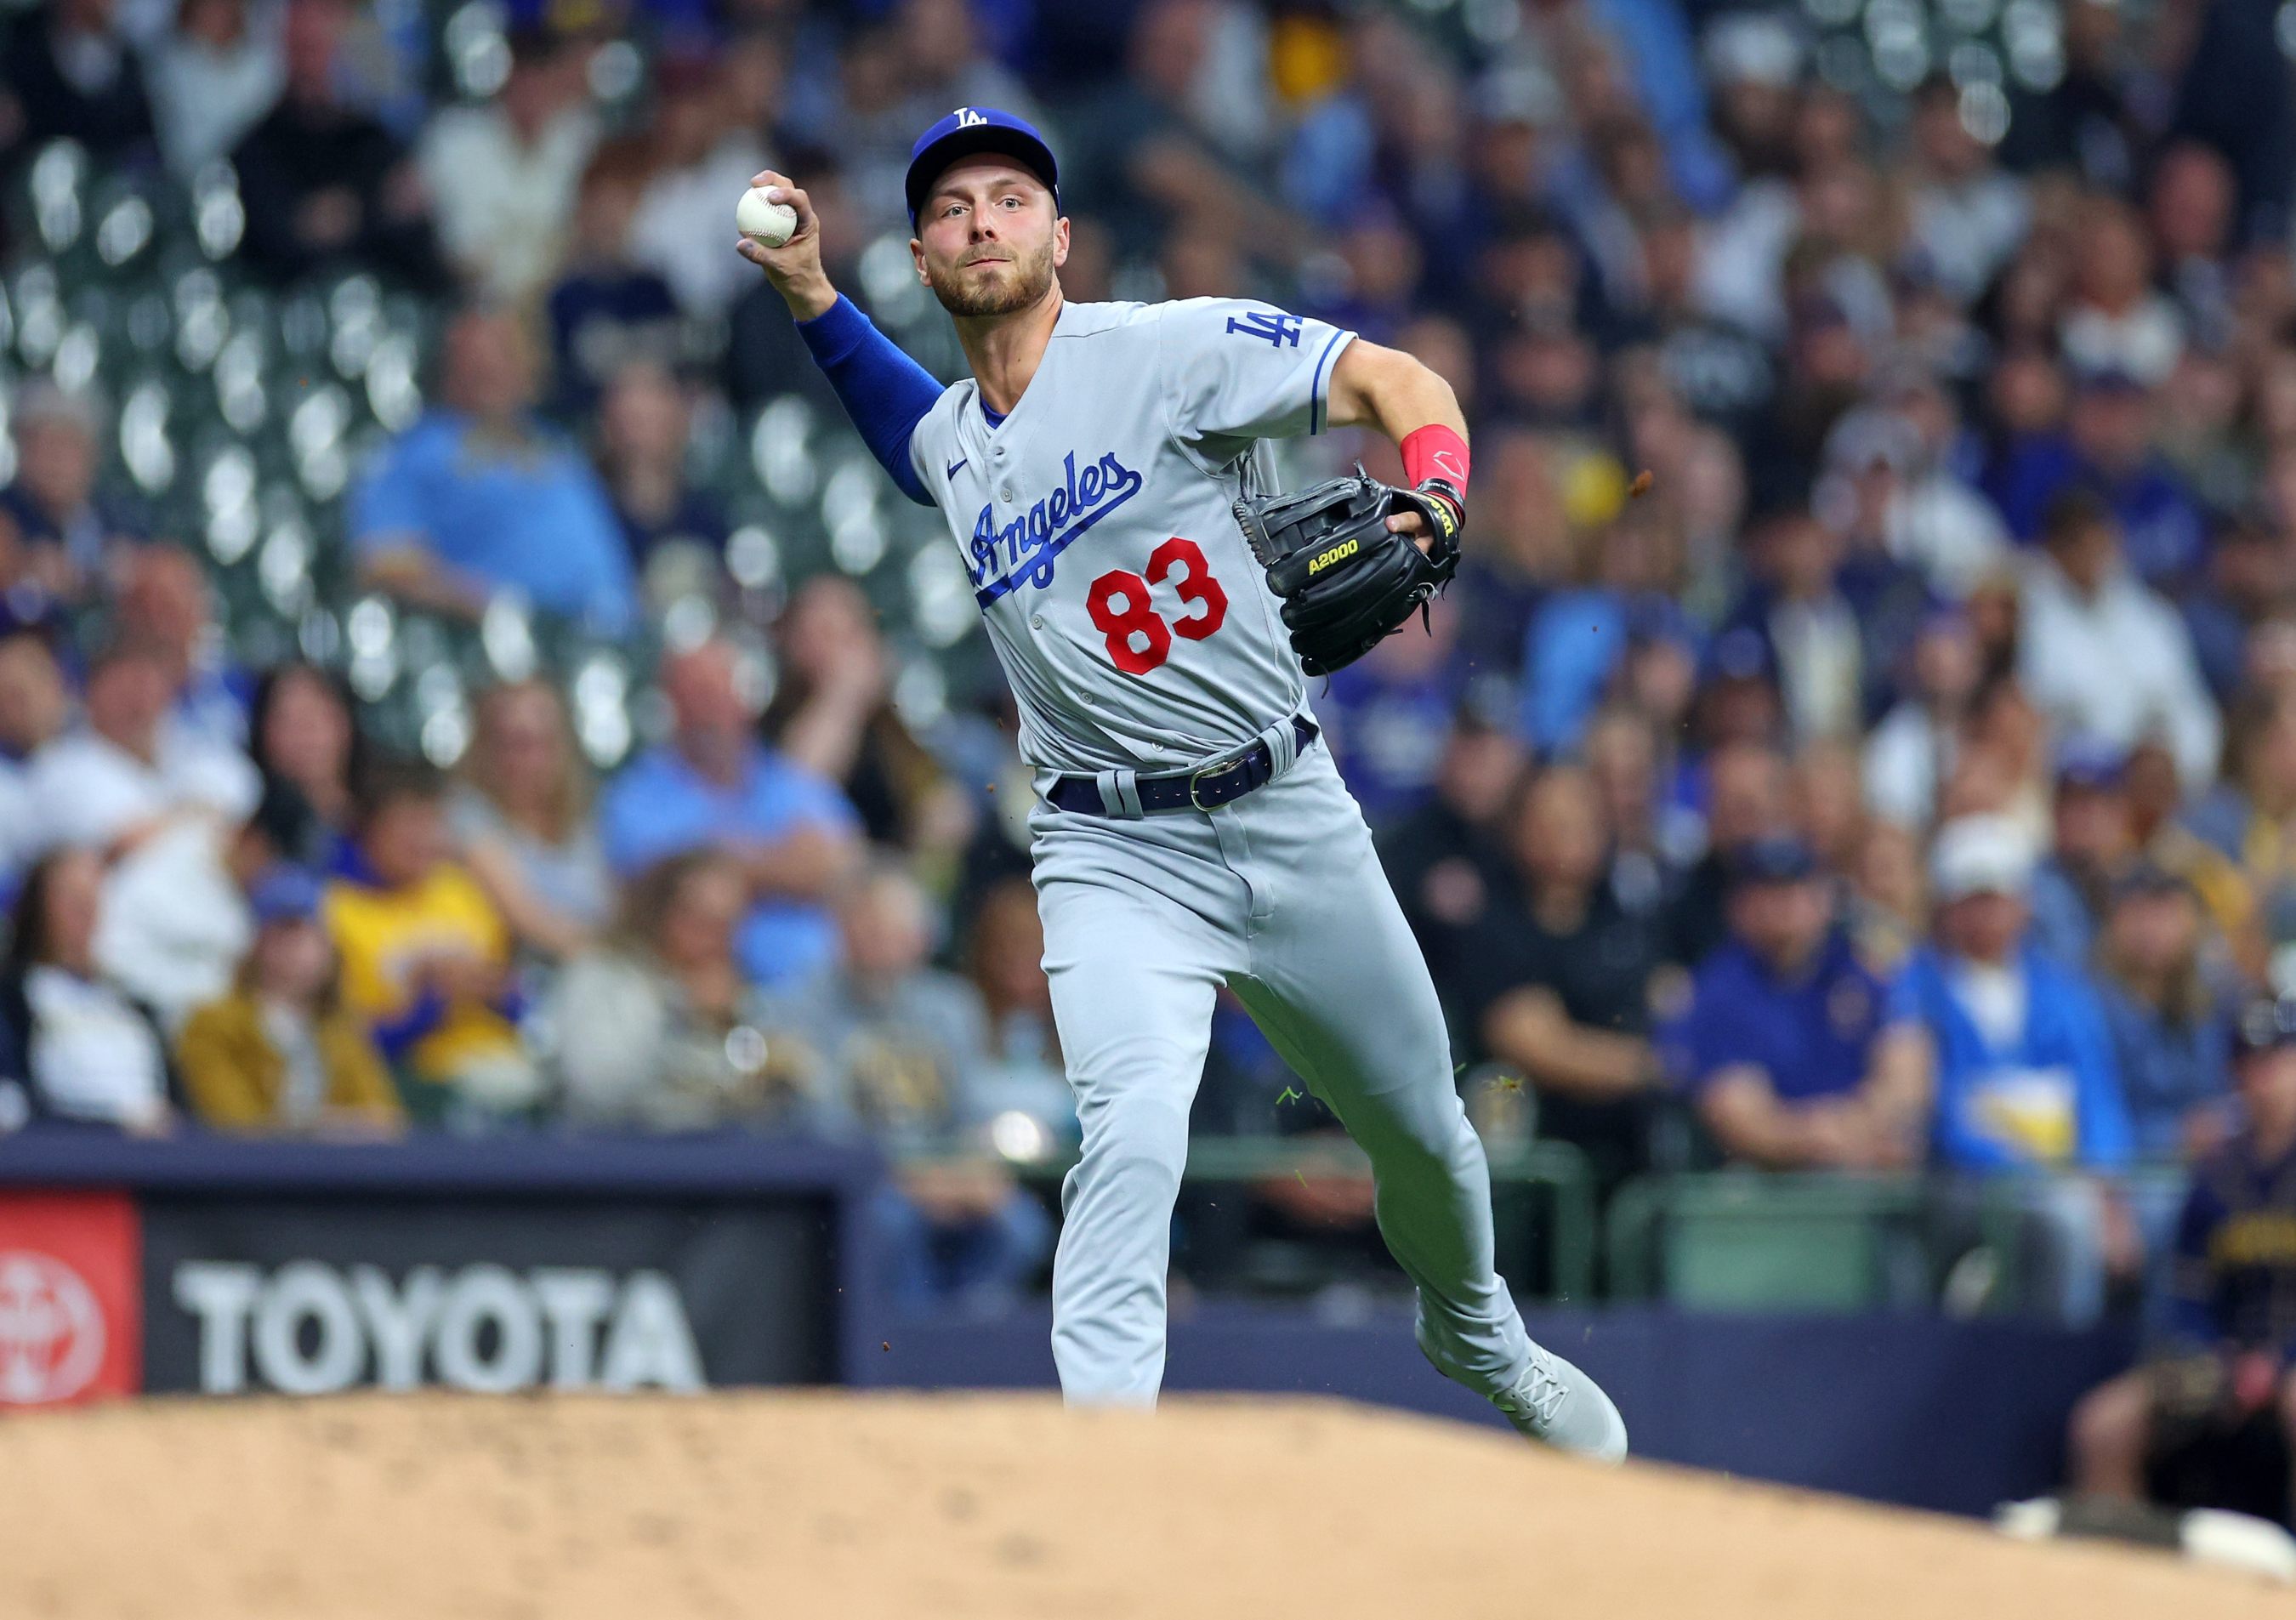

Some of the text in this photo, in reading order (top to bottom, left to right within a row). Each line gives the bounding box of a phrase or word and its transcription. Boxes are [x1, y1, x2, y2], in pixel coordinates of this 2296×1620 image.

[953, 107, 988, 129] LA
[1226, 311, 1303, 348] LA
[971, 450, 1142, 589] Angeles
[1308, 538, 1359, 577] A2000
[1086, 537, 1228, 675] 83
[174, 1259, 708, 1395] TOYOTA
